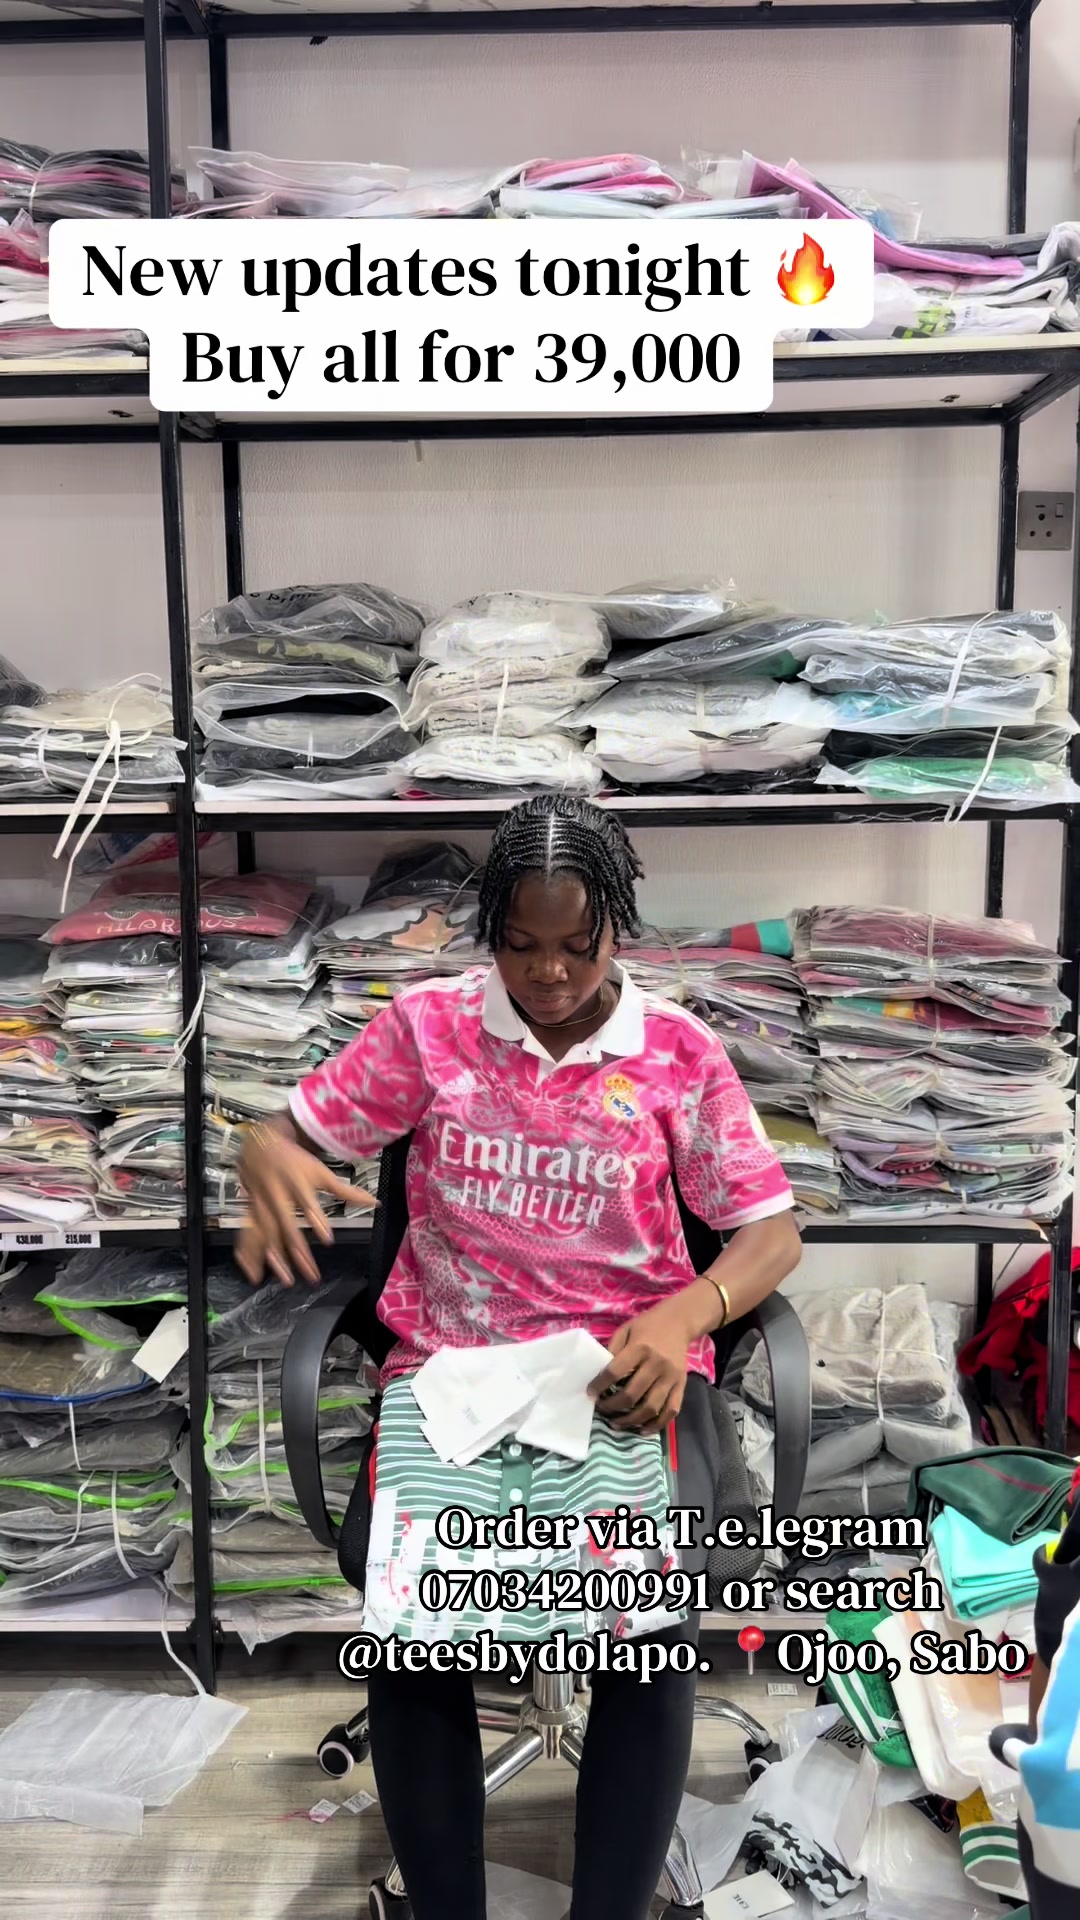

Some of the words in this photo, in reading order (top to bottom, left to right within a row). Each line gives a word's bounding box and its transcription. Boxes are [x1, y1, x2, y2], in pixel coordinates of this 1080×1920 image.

[440, 1120, 640, 1190] Emirates
[460, 1176, 502, 1213] FLY
[508, 1182, 605, 1227] BETTER
